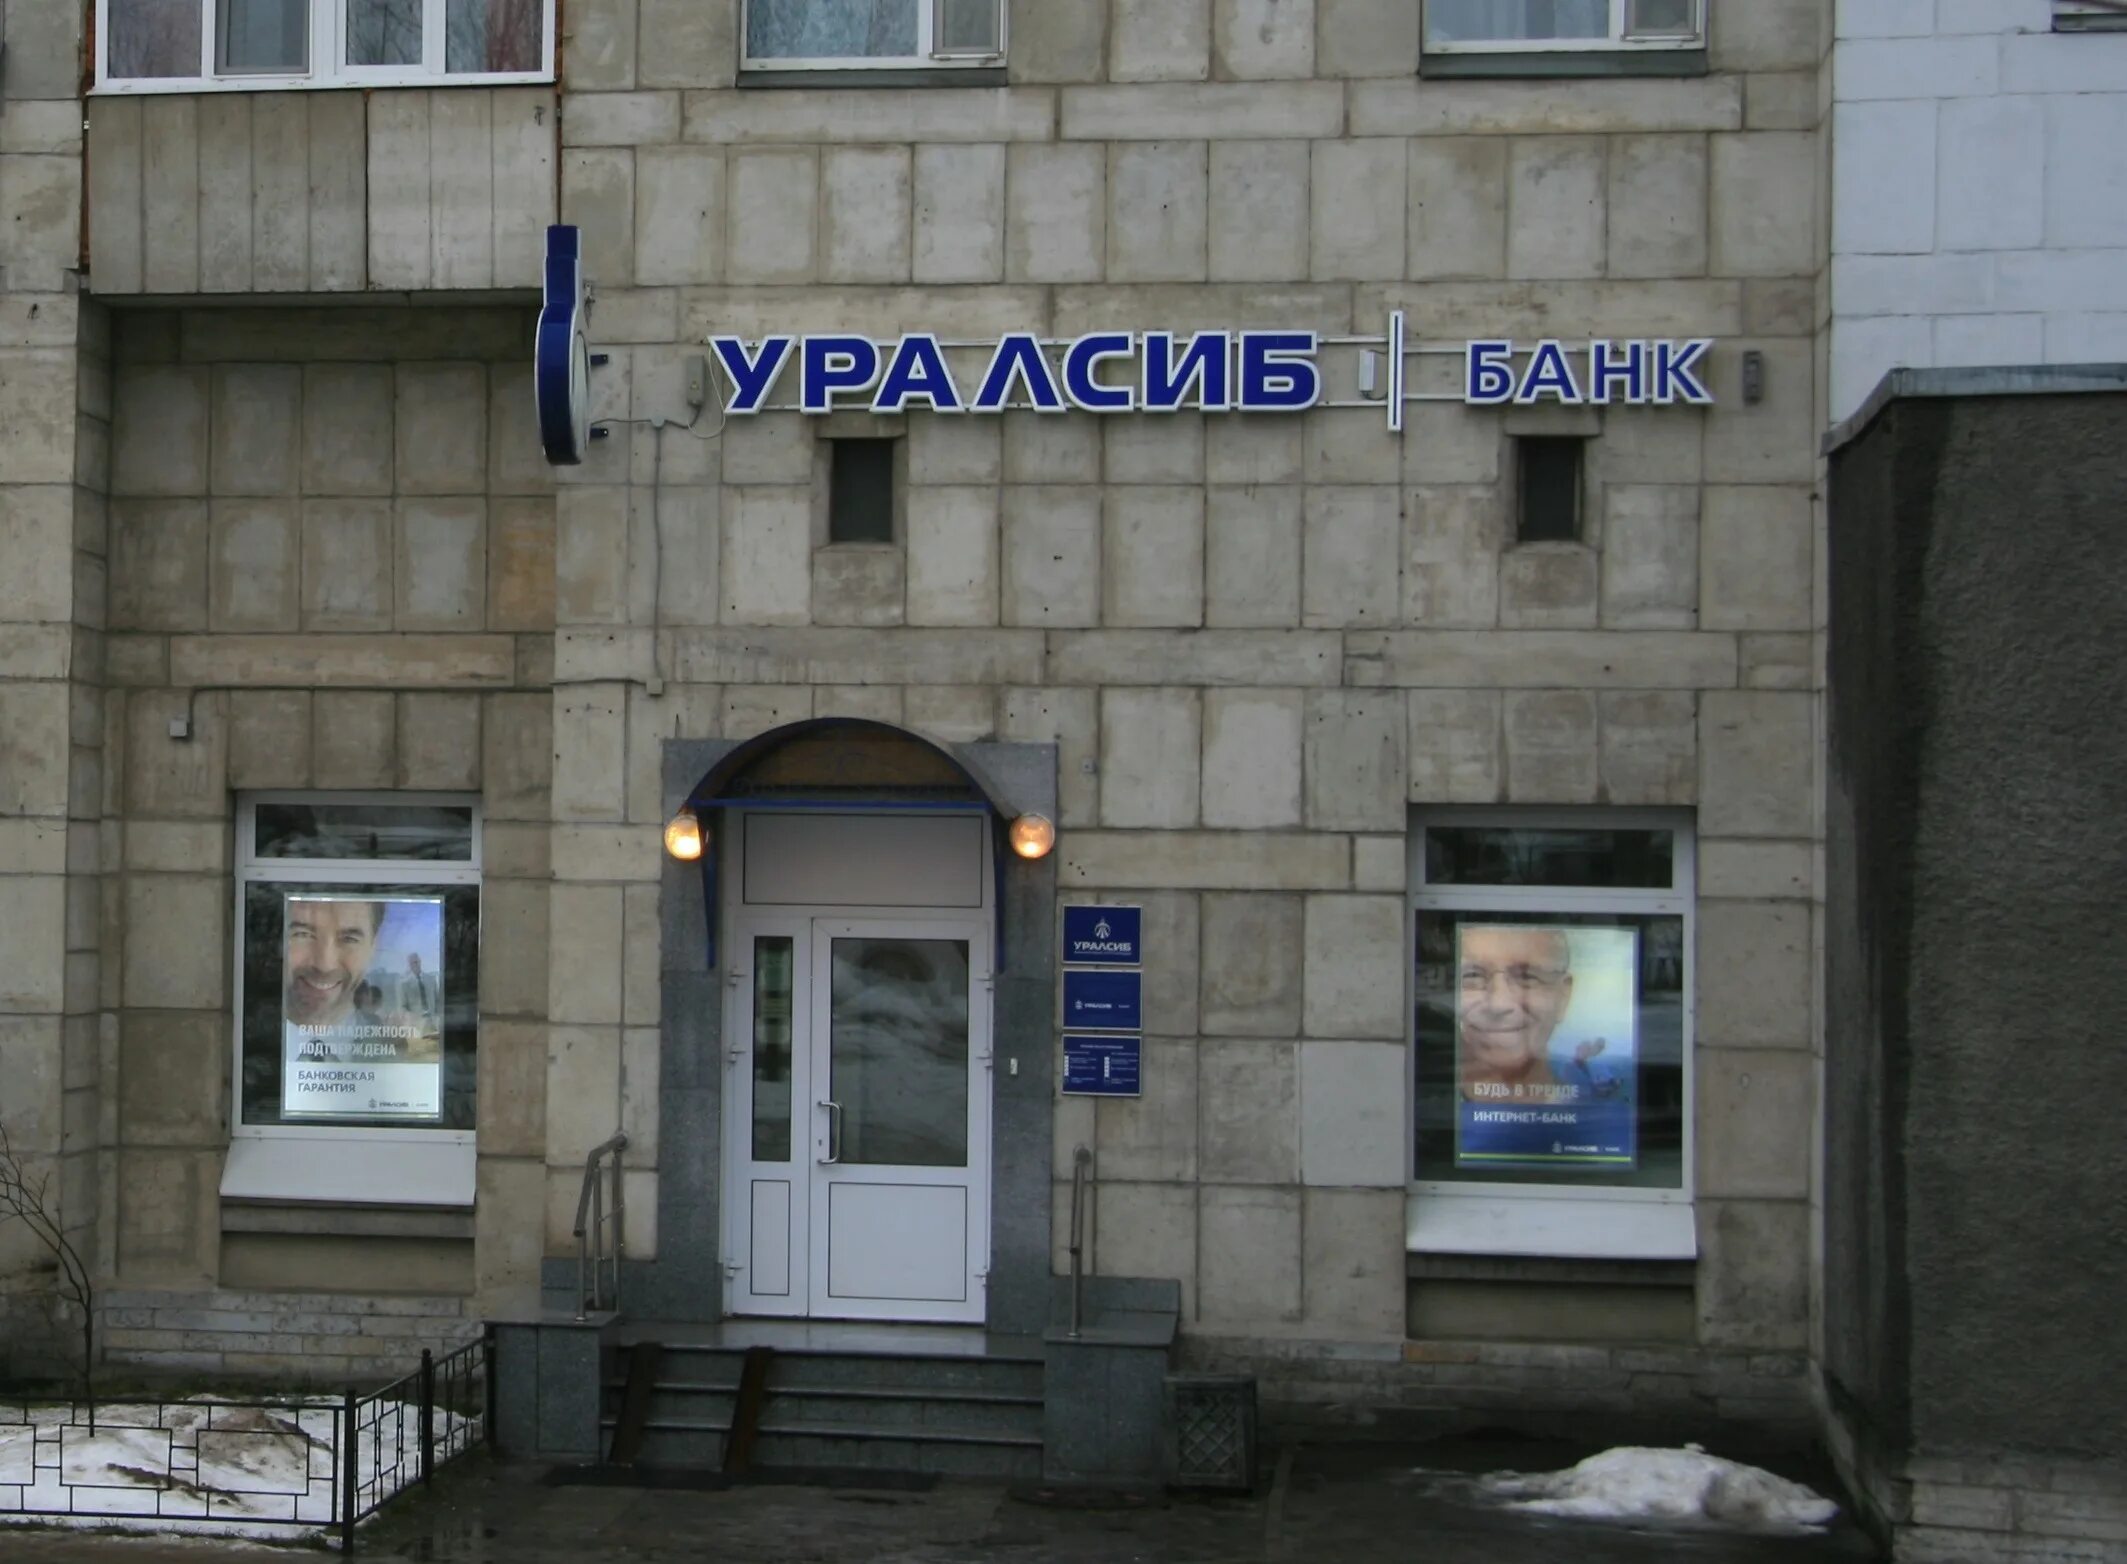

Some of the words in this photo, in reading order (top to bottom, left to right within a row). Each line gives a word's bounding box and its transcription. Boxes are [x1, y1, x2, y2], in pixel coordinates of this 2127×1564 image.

[708, 331, 1321, 413] УРАЛСИБ
[1465, 338, 1714, 405] БАНК
[1073, 941, 1132, 951] УРАЛСИБ
[299, 1024, 334, 1037] ВАША
[338, 1024, 421, 1039] НАДЕЖНОСТЬ
[299, 1043, 396, 1057] ПОДТВЕРЖДЕНА
[298, 1070, 375, 1082] БАНКОВСКАЯ
[298, 1082, 356, 1093] ГАРАНТИЯ
[1473, 1082, 1510, 1097] БУДЬ
[1514, 1083, 1523, 1097] В
[1528, 1083, 1579, 1098] ТРЕНДЕ
[1473, 1111, 1577, 1124] ИНТЕРНЕТ-БАНК
